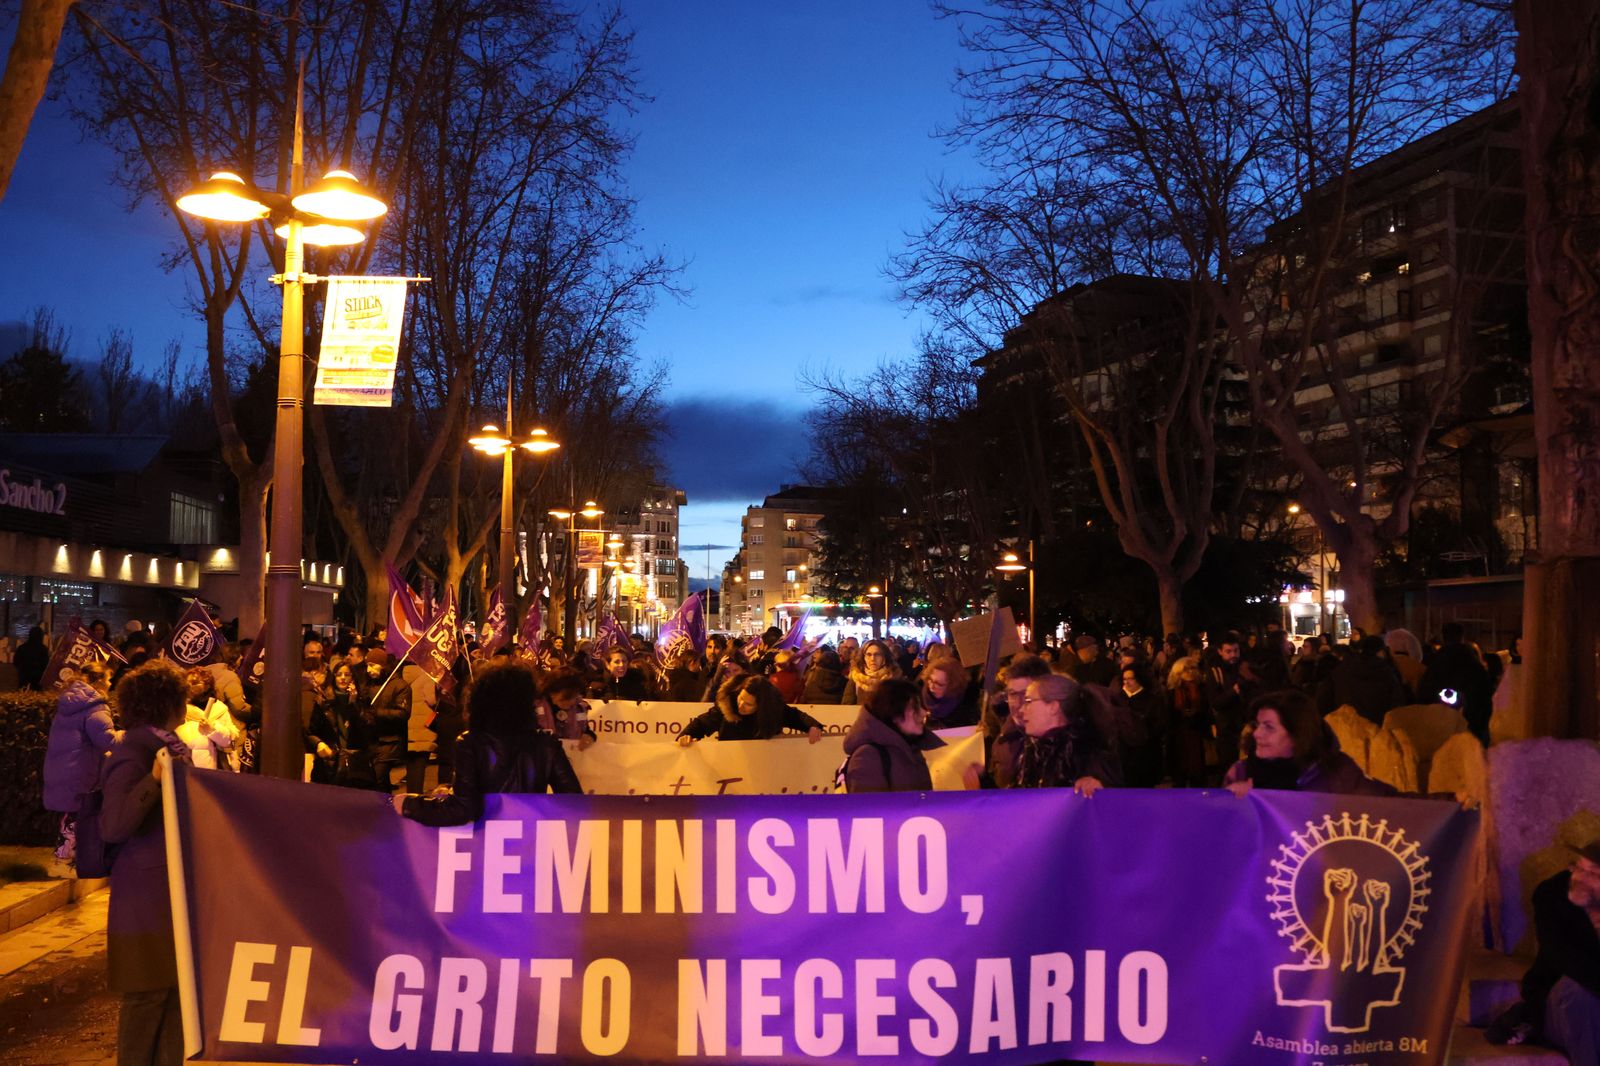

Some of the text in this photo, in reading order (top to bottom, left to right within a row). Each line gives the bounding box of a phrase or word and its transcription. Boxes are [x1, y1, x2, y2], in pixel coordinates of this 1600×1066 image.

[427, 623, 452, 652] UG
[655, 721, 682, 734] no
[435, 816, 984, 925] FEMINISMO,
[219, 941, 1169, 1057] EL GRITO NECESARIO
[1252, 1030, 1428, 1056] Asamblea abierta 8M
